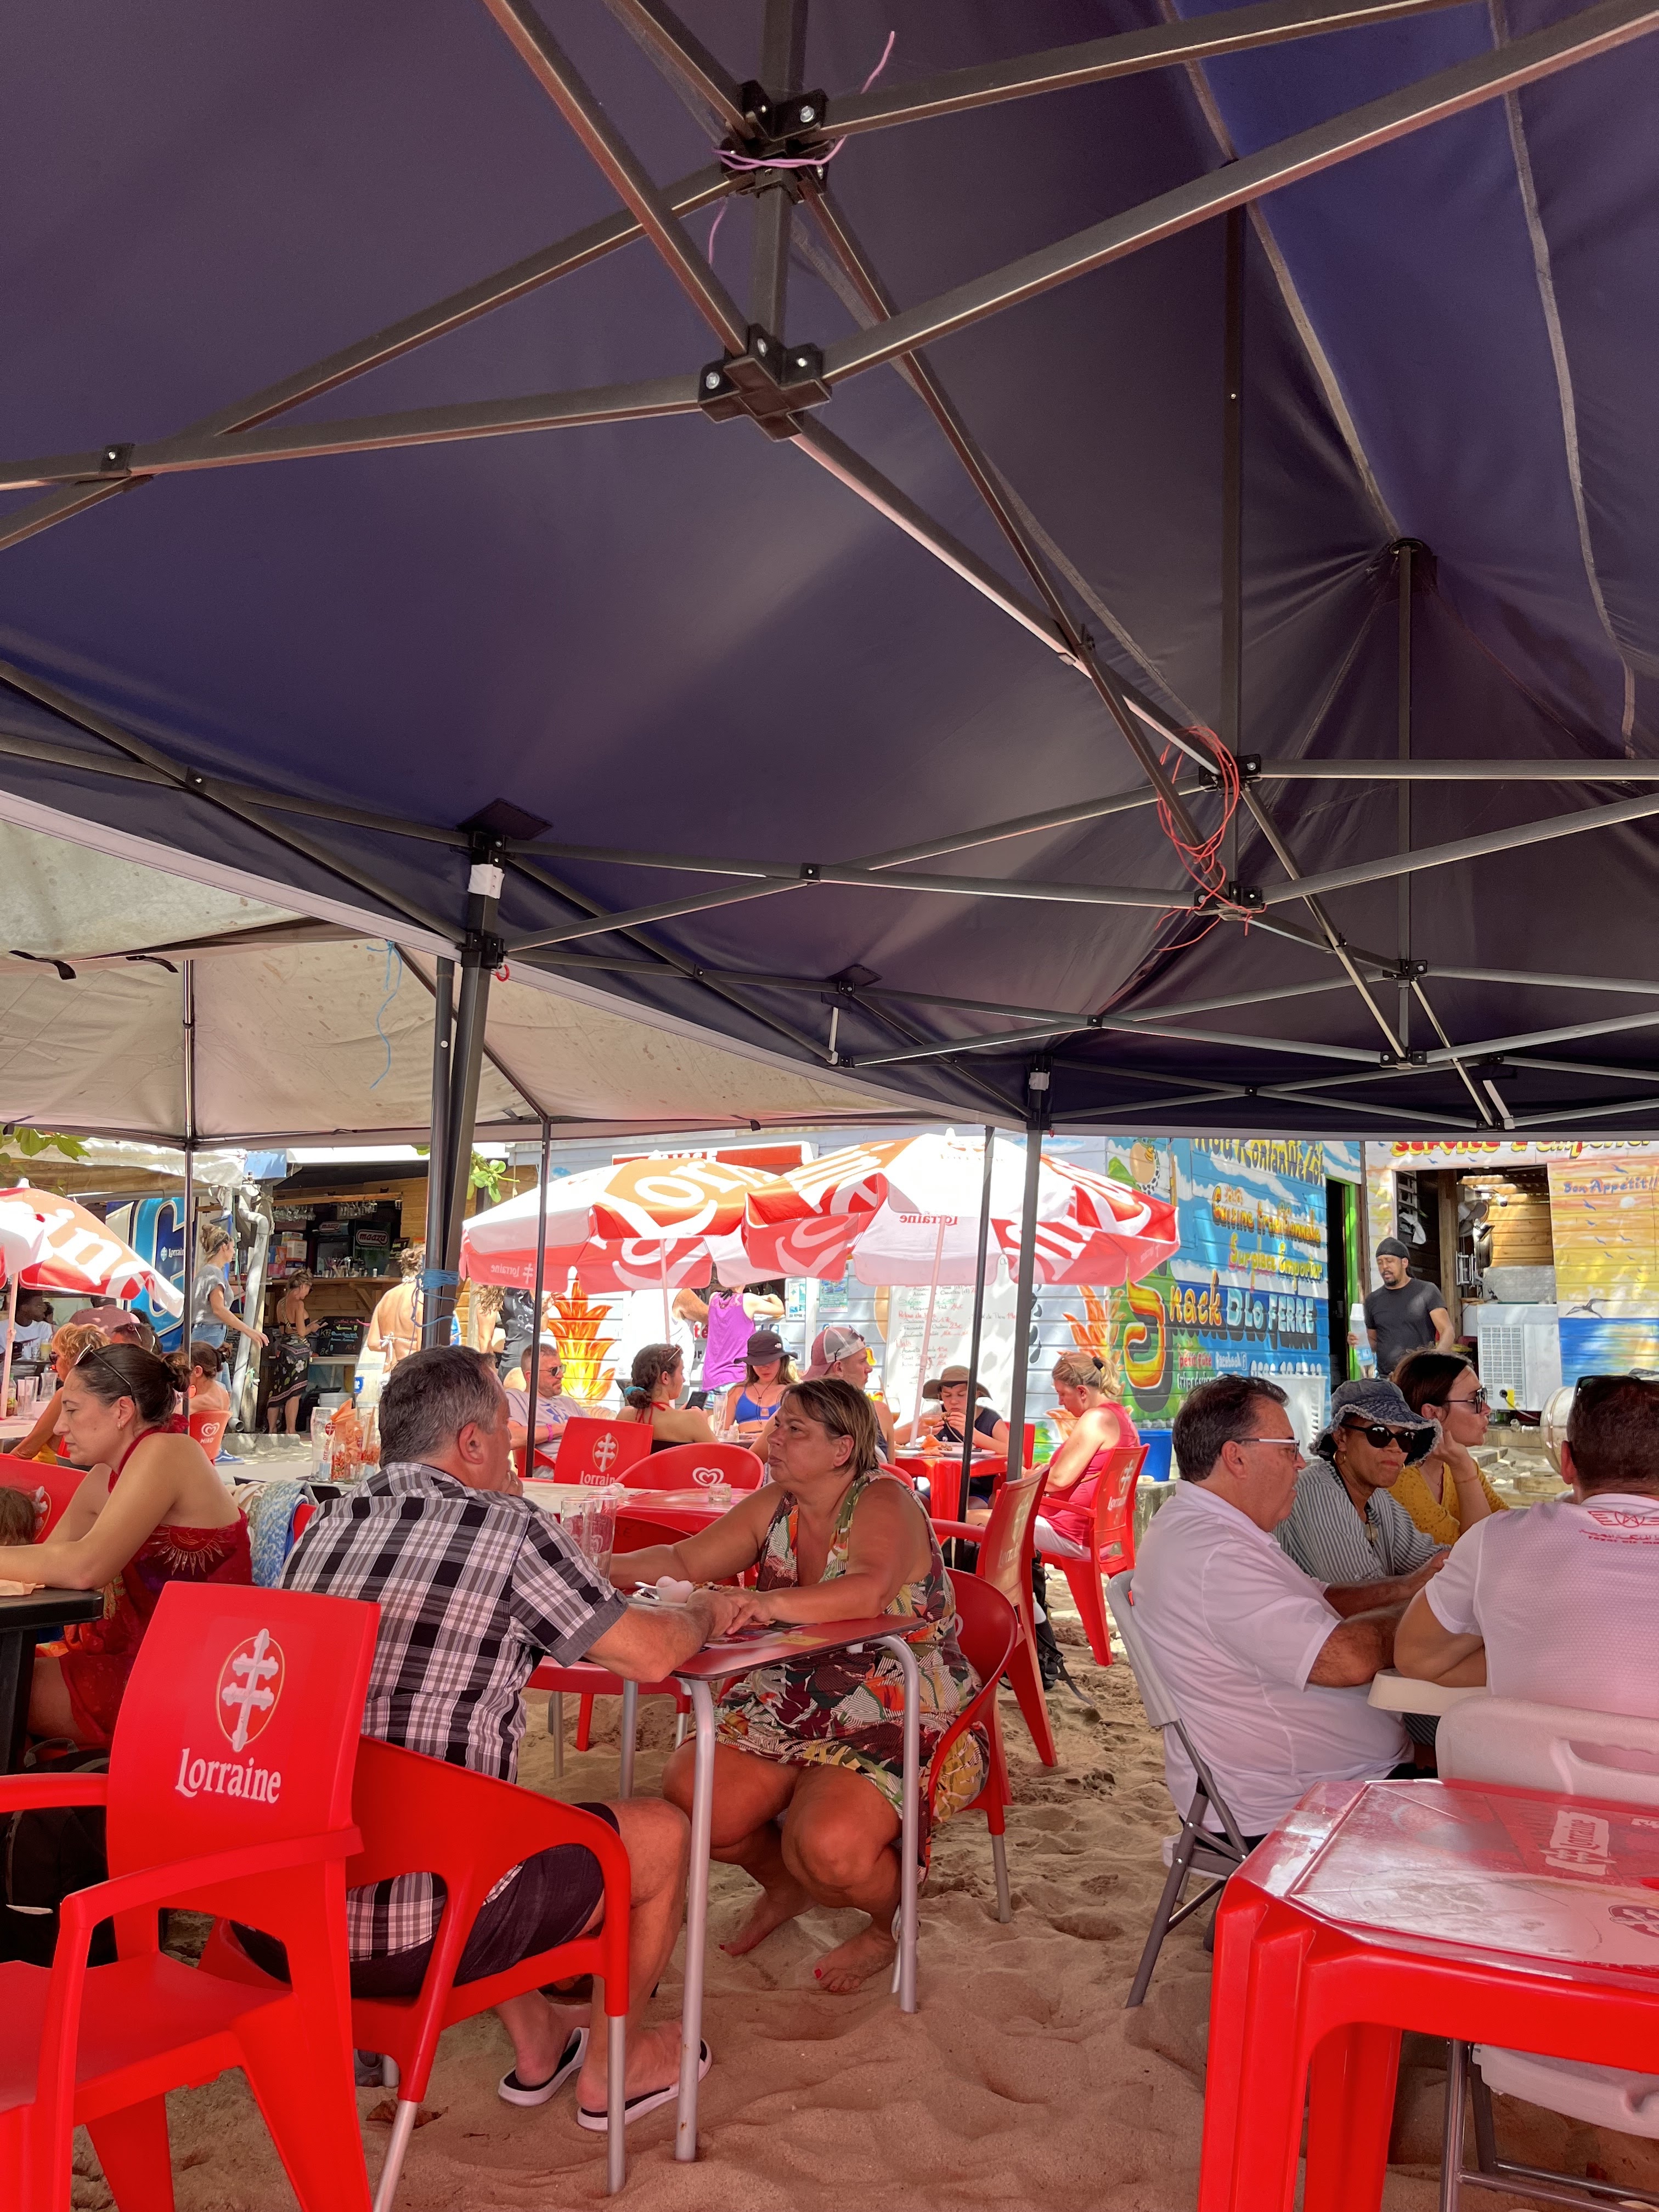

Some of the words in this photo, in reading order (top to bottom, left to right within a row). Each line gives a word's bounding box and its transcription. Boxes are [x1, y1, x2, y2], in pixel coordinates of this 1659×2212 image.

[1564, 1181, 1587, 1194] Bon
[359, 1233, 386, 1244] maaza
[168, 1249, 184, 1259] Lorrain
[1268, 1294, 1316, 1335] FERRE
[579, 1470, 616, 1486] Lorrain
[1107, 1496, 1127, 1511] Lorra
[176, 1748, 281, 1804] Lorraine
[1560, 1819, 1600, 1850] Lorraine
